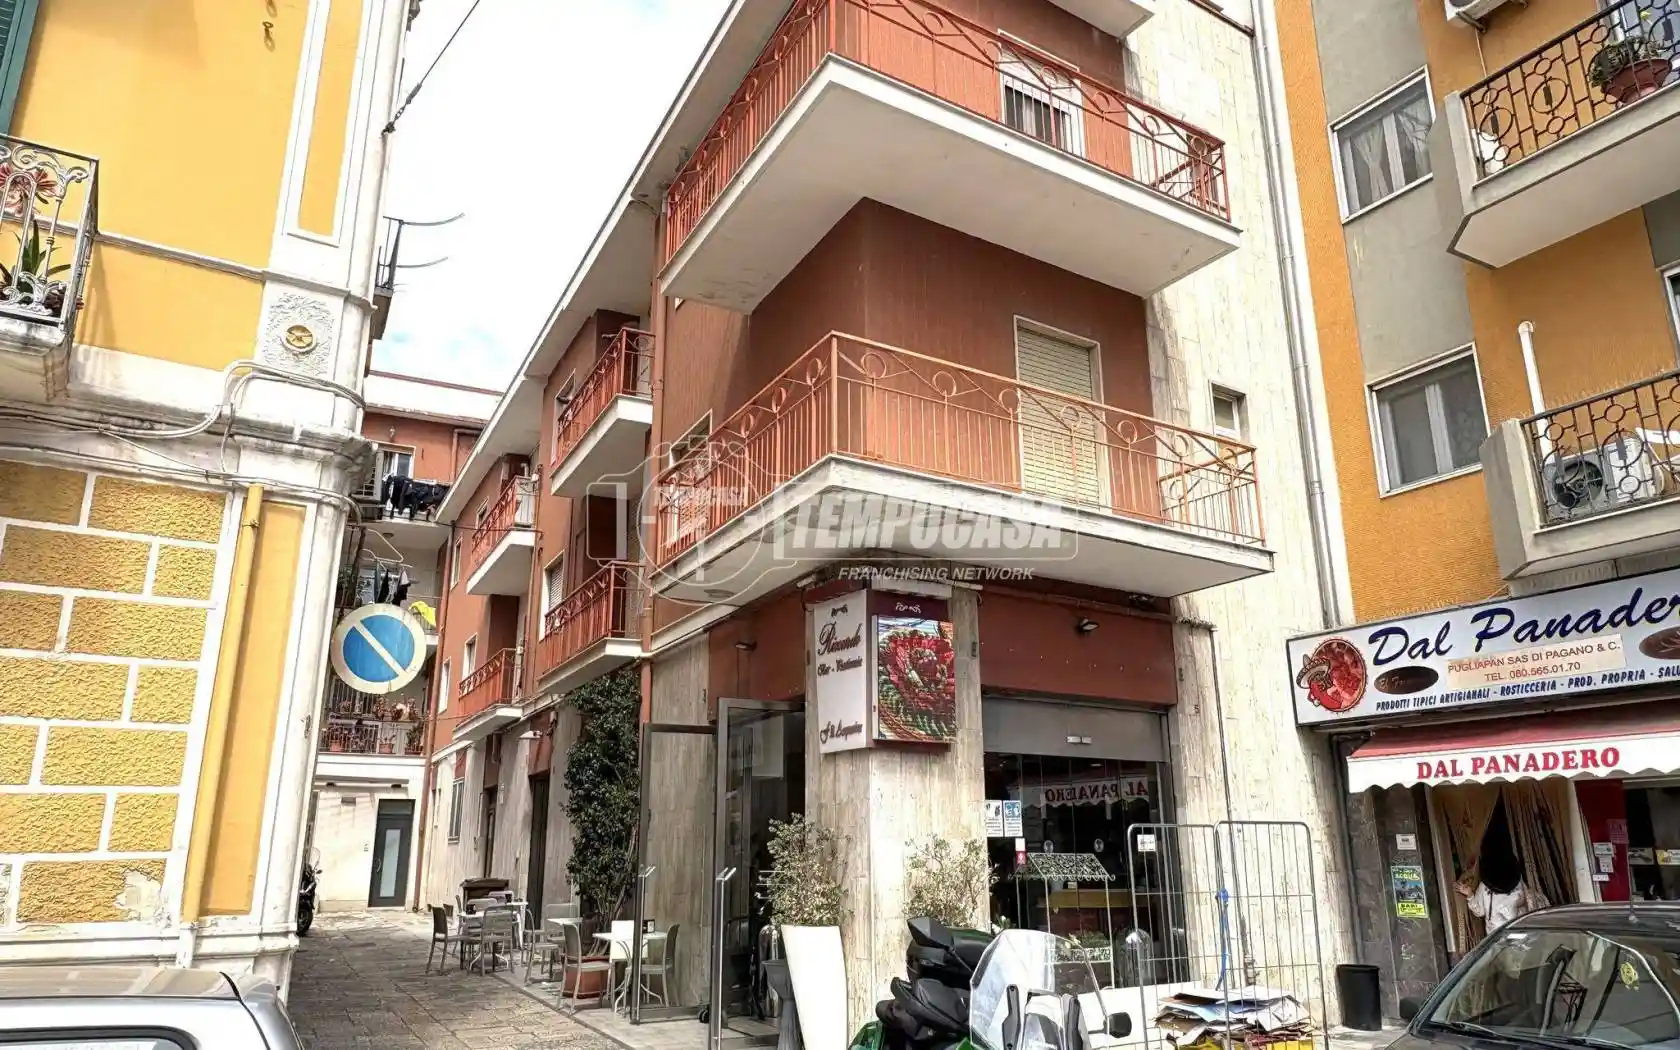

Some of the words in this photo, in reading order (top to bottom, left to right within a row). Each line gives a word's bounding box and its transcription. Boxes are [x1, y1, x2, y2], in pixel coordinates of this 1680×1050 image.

[1368, 621, 1453, 666] Dal
[1447, 657, 1505, 674] PUGLIAPAN
[1507, 653, 1529, 665] SAS
[1531, 652, 1543, 662] DI
[1545, 645, 1594, 660] PAGANO
[1596, 642, 1605, 652] &
[1608, 641, 1621, 651] C.
[1484, 673, 1507, 682] TEL.
[1509, 661, 1581, 678] 080.565.01.70
[1376, 698, 1410, 711] PRODOTTI
[1413, 695, 1437, 707] TIPICI
[1440, 688, 1490, 704] ARTIGIANALI
[1500, 680, 1557, 697] ROSTICCERIA
[1567, 675, 1597, 689] PROD.
[1601, 669, 1646, 685] PROPRIA
[1417, 759, 1463, 779] DAL
[1471, 747, 1620, 775] PANADERO
